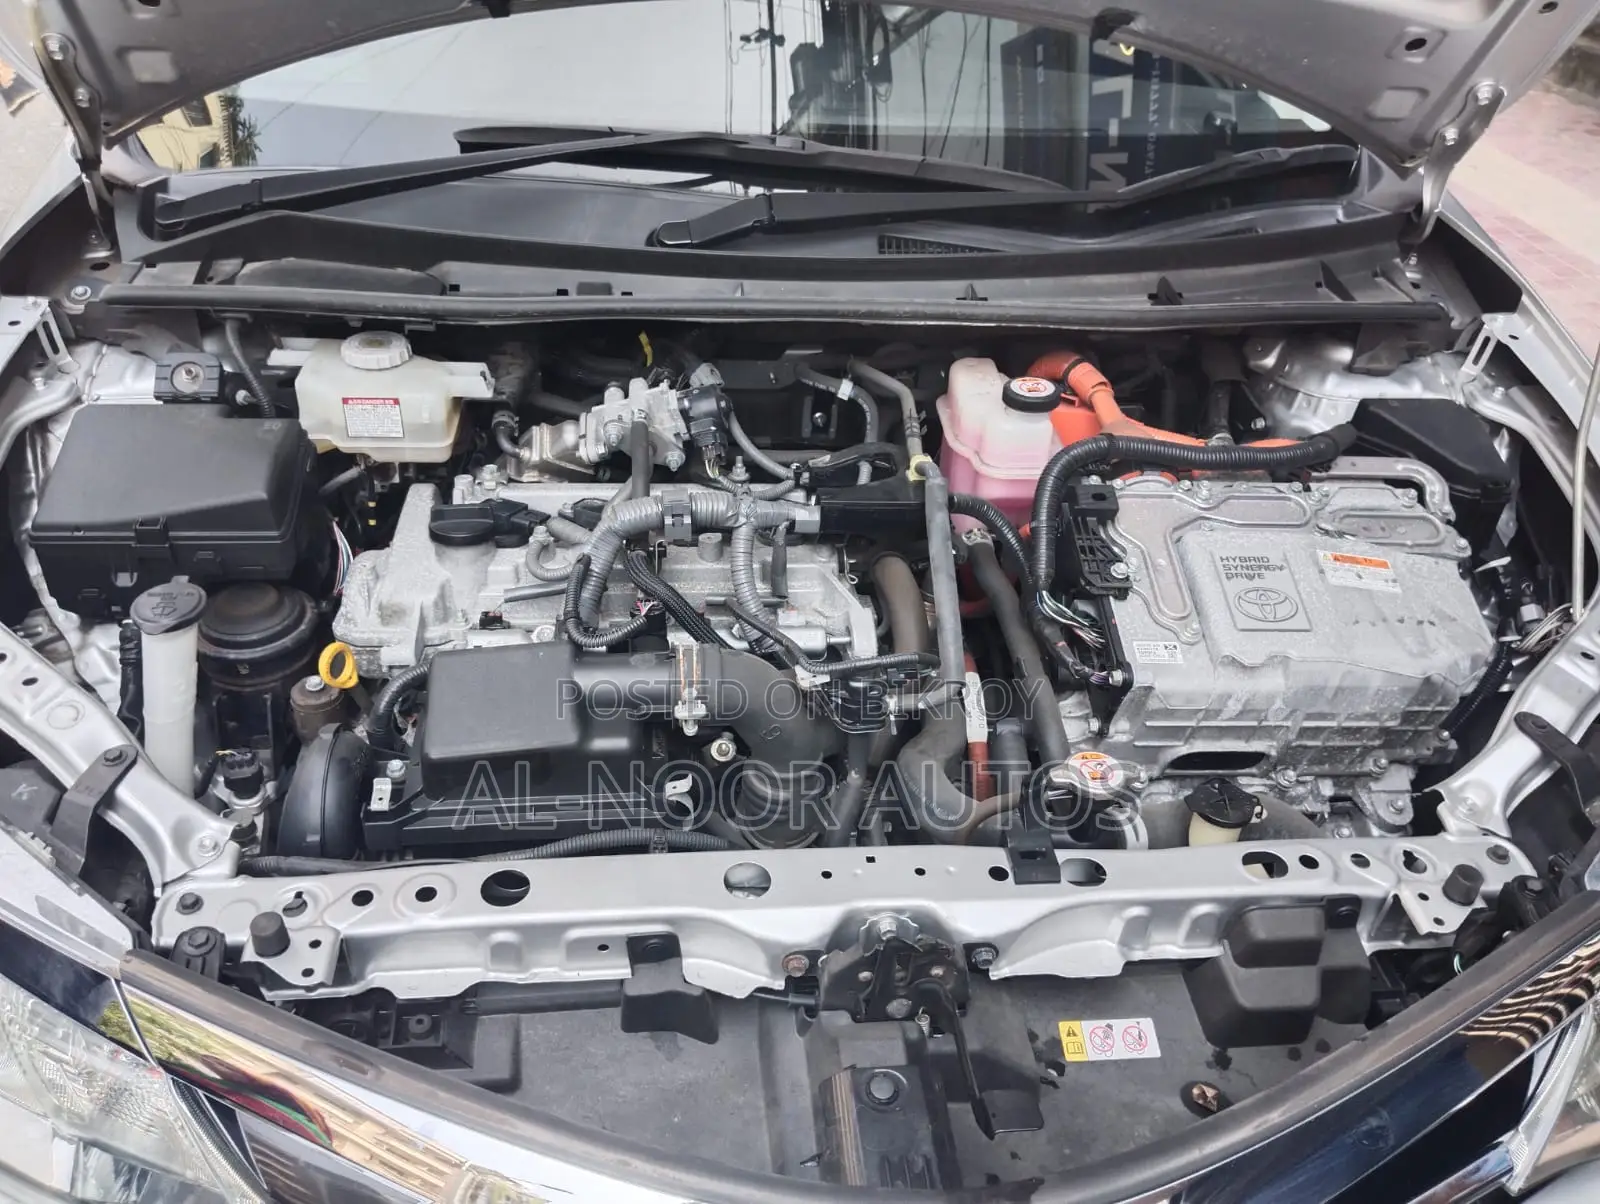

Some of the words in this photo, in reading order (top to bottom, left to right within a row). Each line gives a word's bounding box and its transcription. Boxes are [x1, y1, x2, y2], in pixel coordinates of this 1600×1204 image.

[1219, 555, 1270, 564] HYBRID
[1222, 563, 1287, 572] SYNERGY
[1224, 572, 1266, 582] DRIVE
